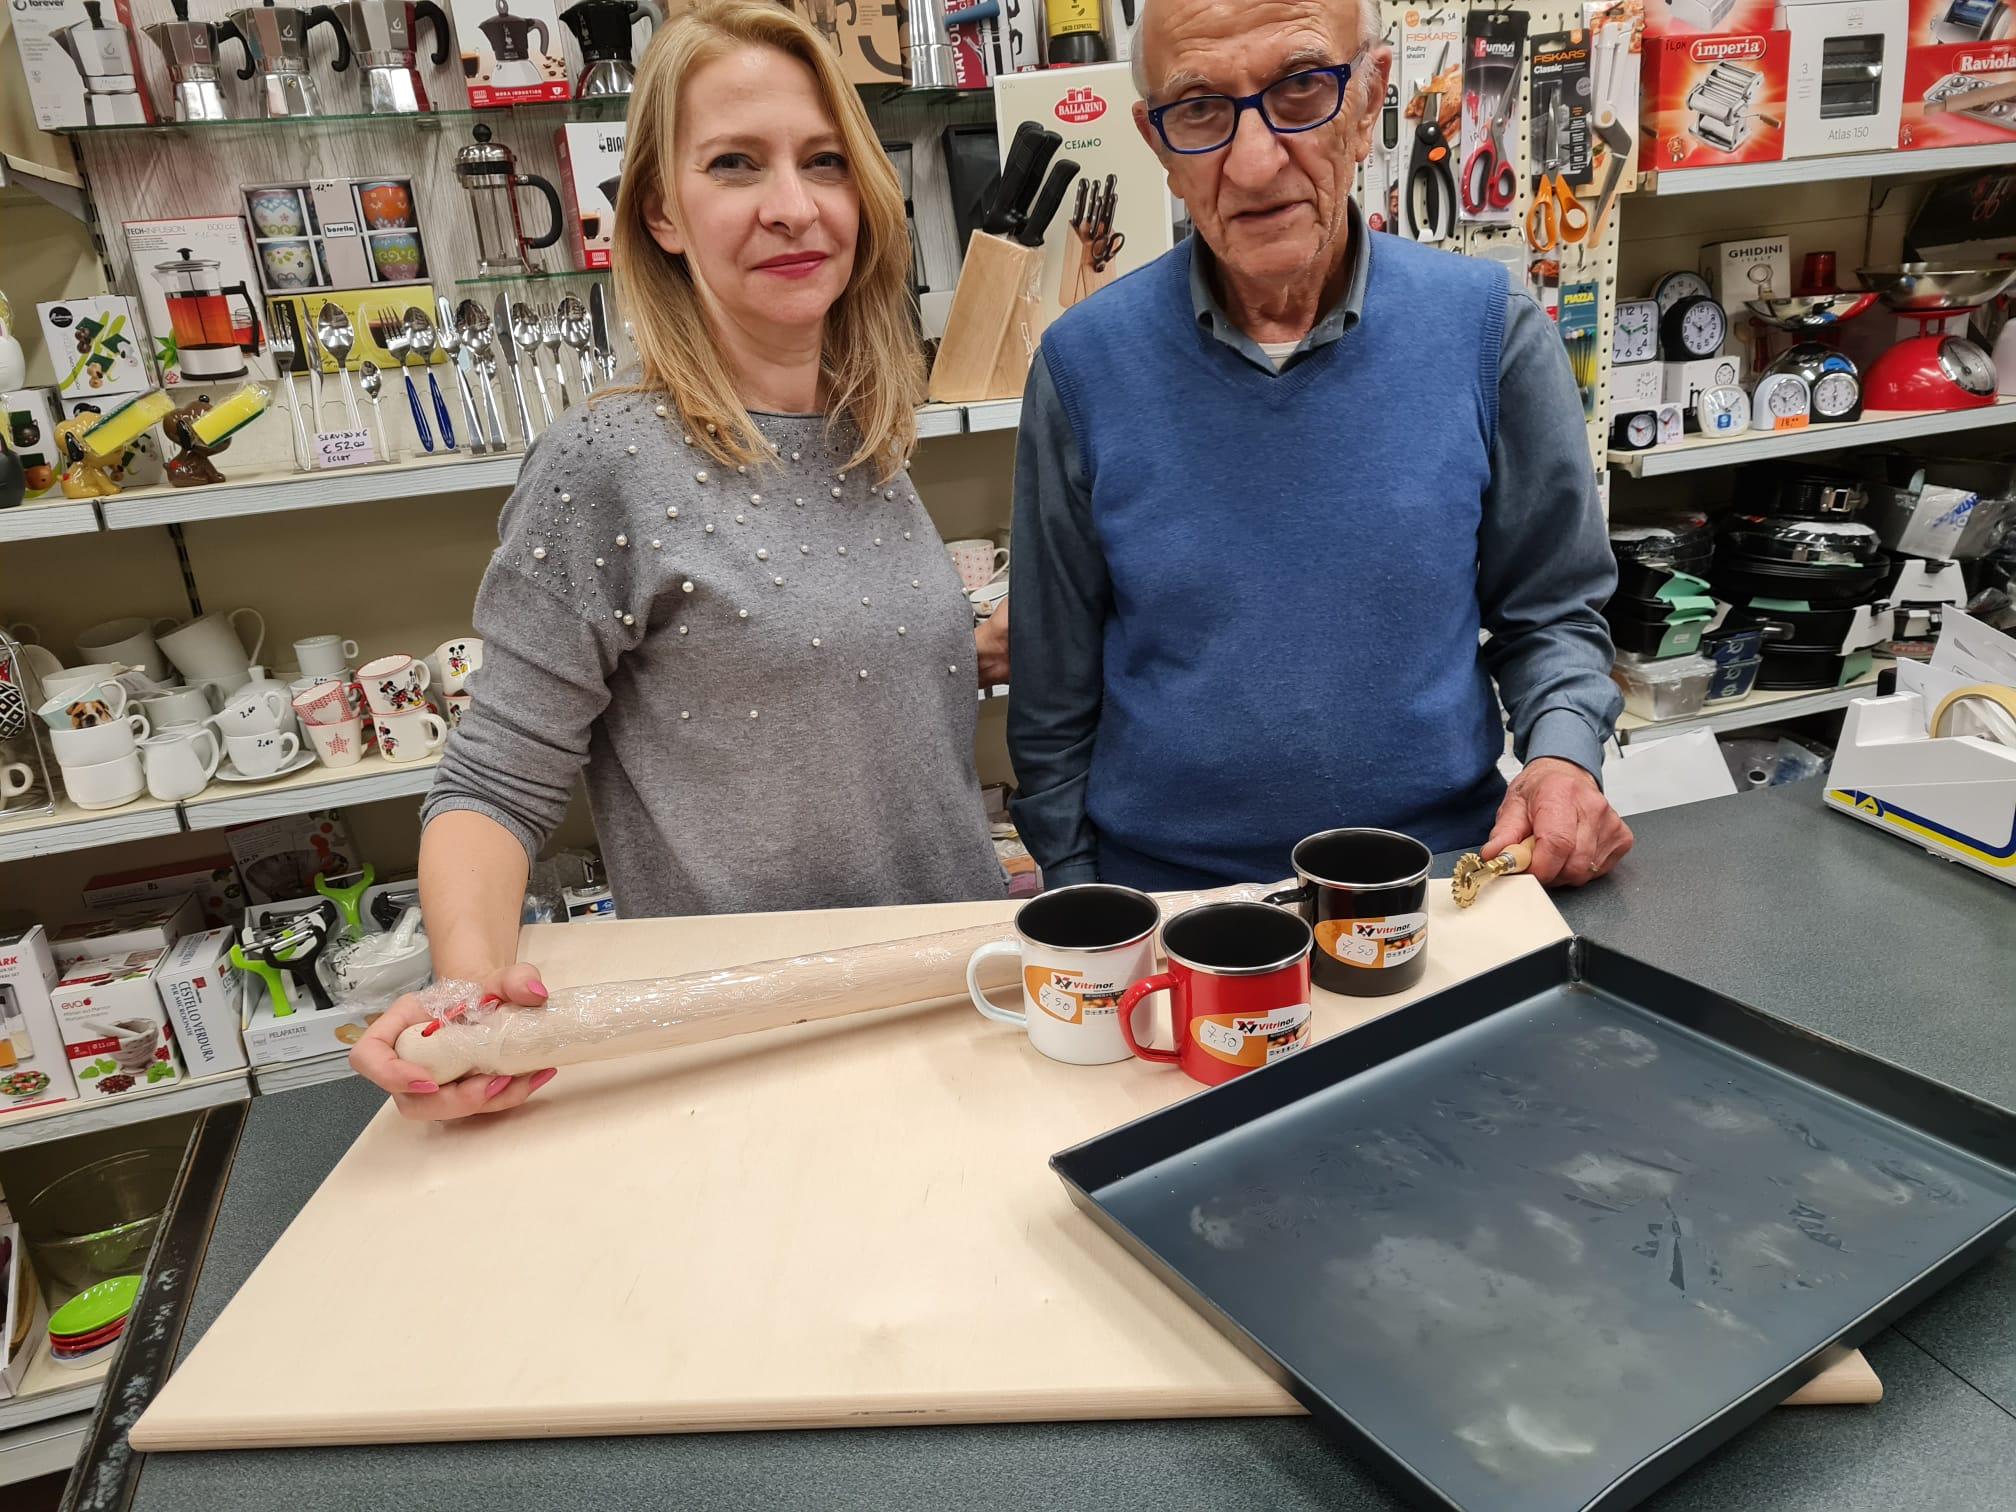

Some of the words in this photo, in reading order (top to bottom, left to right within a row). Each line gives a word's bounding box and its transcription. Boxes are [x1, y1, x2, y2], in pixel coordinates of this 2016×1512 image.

[1406, 31, 1458, 41] FISKARS
[1697, 39, 1760, 59] imperia
[1533, 49, 1586, 64] FISKARS
[1534, 64, 1562, 74] Classic
[1058, 101, 1103, 116] BALLARINI
[1828, 129, 1852, 141] Atlas
[1854, 126, 1869, 138] 150
[1064, 138, 1102, 150] CESANO
[1728, 244, 1783, 258] GHIDINI
[1376, 924, 1411, 935] Vitrinor
[1073, 982, 1114, 990] Vitrinor
[61, 1000, 83, 1010] eva
[178, 981, 201, 1022] CESTELLO
[194, 1021, 215, 1063] VERDURA
[1259, 1018, 1294, 1031] Vitrinor
[269, 1026, 306, 1039] PELAPATATE
